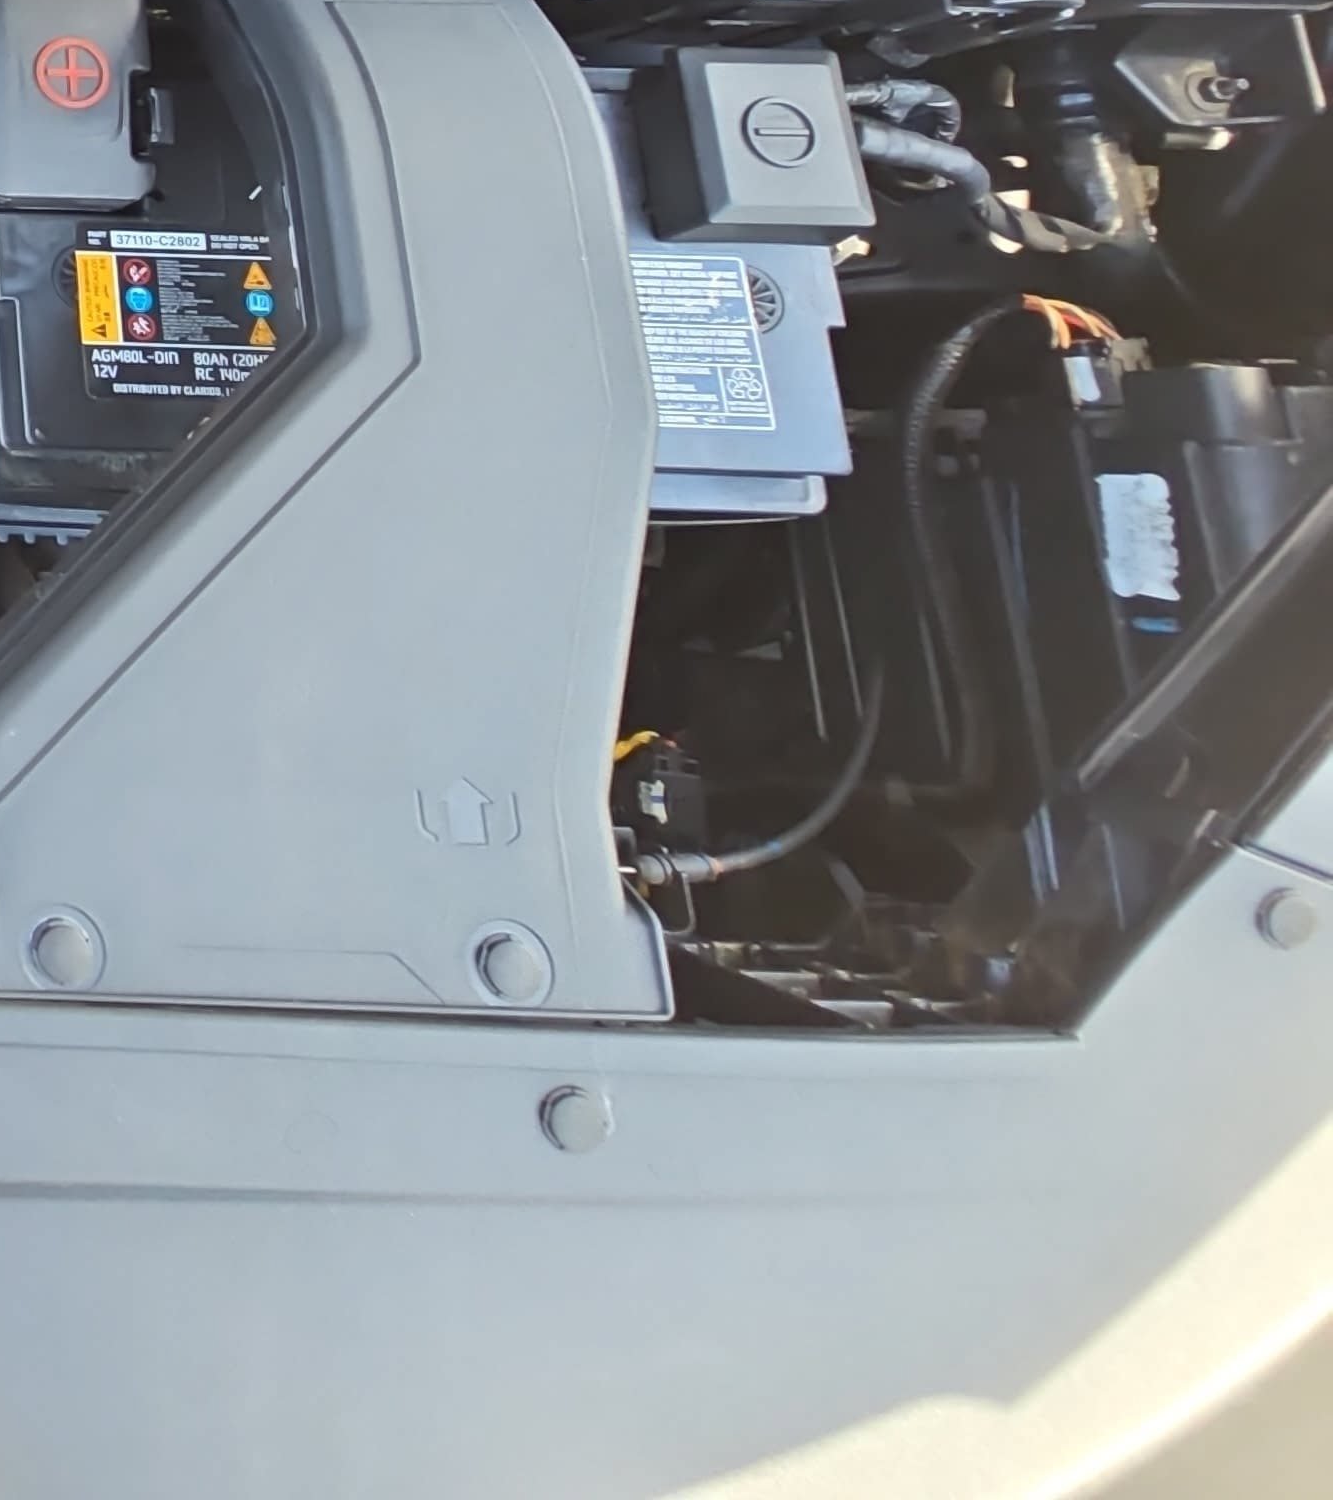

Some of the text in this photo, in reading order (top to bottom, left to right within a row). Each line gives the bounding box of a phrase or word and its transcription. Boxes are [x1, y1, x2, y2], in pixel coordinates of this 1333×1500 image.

[115, 234, 201, 248] 37110-C2802
[193, 351, 229, 366] 80Ah
[93, 364, 118, 379] 12V
[195, 367, 215, 381] RC
